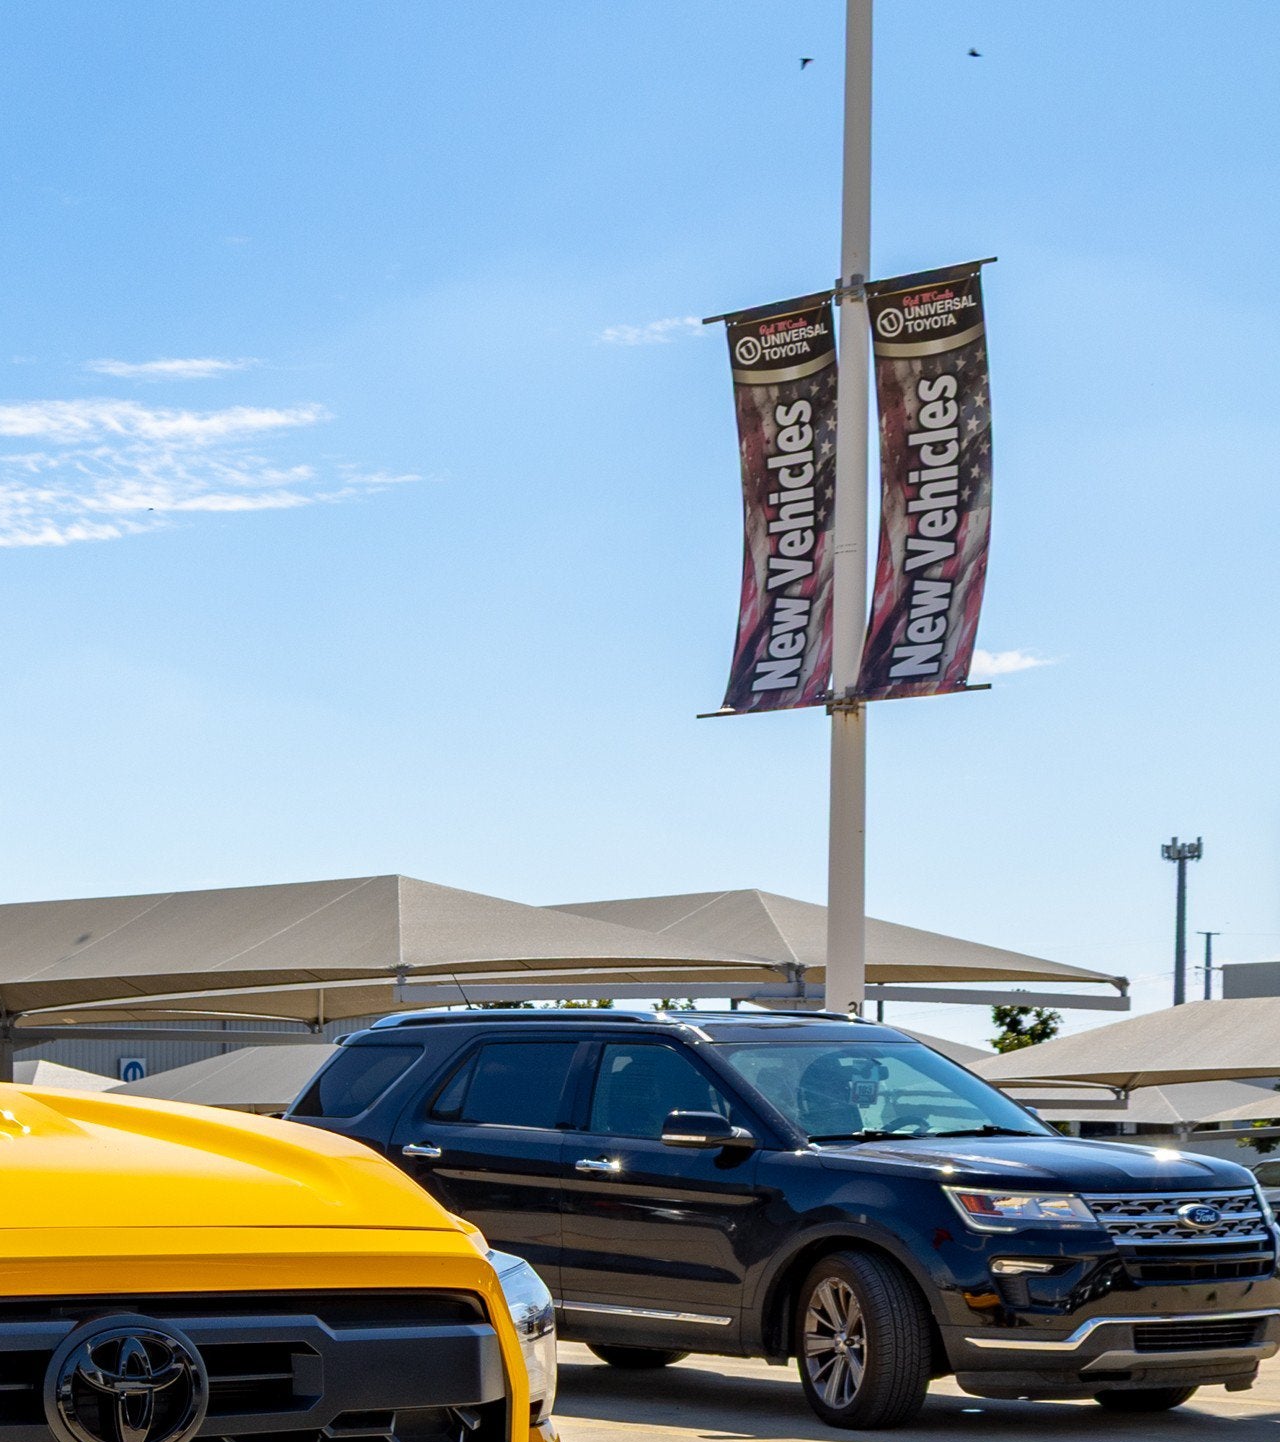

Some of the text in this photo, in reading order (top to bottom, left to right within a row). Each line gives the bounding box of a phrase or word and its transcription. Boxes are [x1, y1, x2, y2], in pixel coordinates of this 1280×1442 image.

[904, 294, 978, 320] UNIVERSAL
[761, 322, 828, 348] UNIVERSAL
[904, 313, 957, 334] TOYOTA
[762, 341, 811, 360] TOYOTA
[889, 373, 958, 679] New Vehicles
[752, 399, 815, 692] New Vehicles
[1195, 1210, 1216, 1222] Ford
